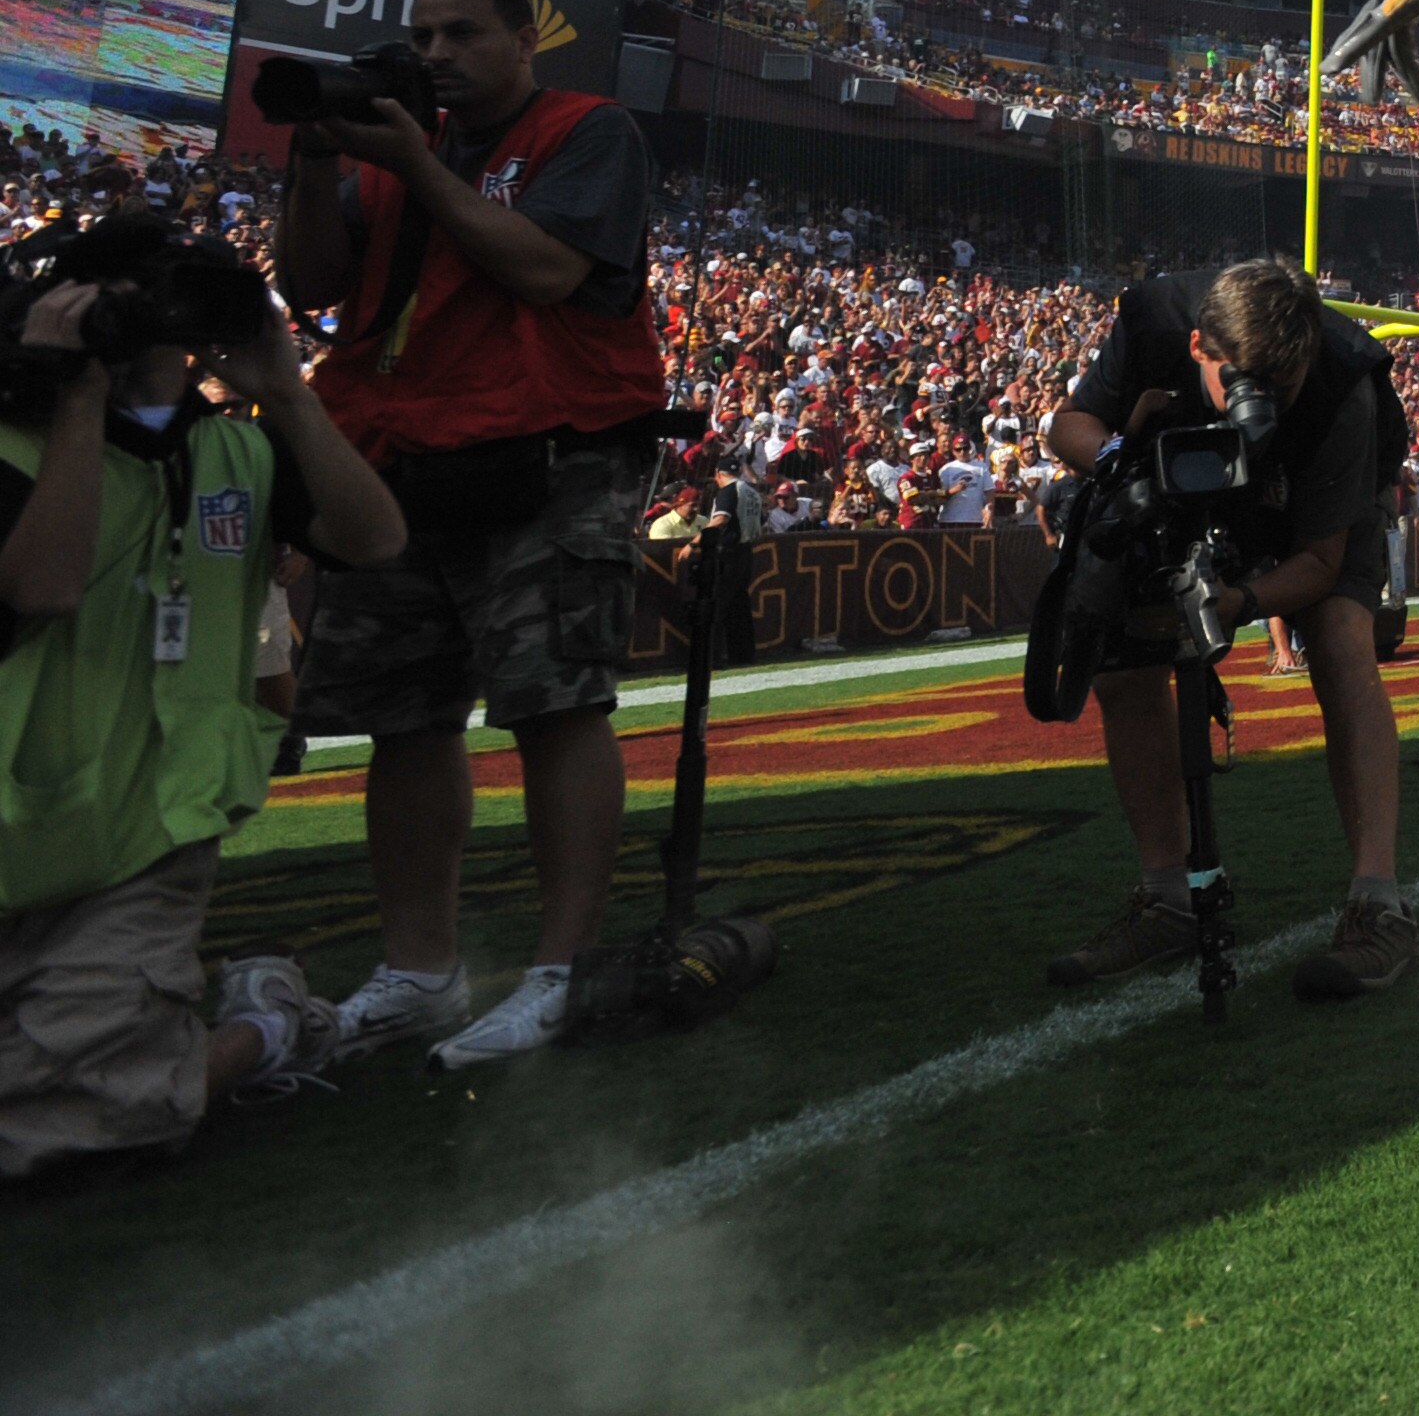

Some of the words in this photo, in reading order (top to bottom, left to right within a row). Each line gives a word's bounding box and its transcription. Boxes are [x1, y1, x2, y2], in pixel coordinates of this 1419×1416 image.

[1166, 136, 1263, 170] REDSKINS
[1274, 151, 1349, 178] LEGCY
[206, 513, 245, 549] NF
[680, 956, 718, 986] Nikon
